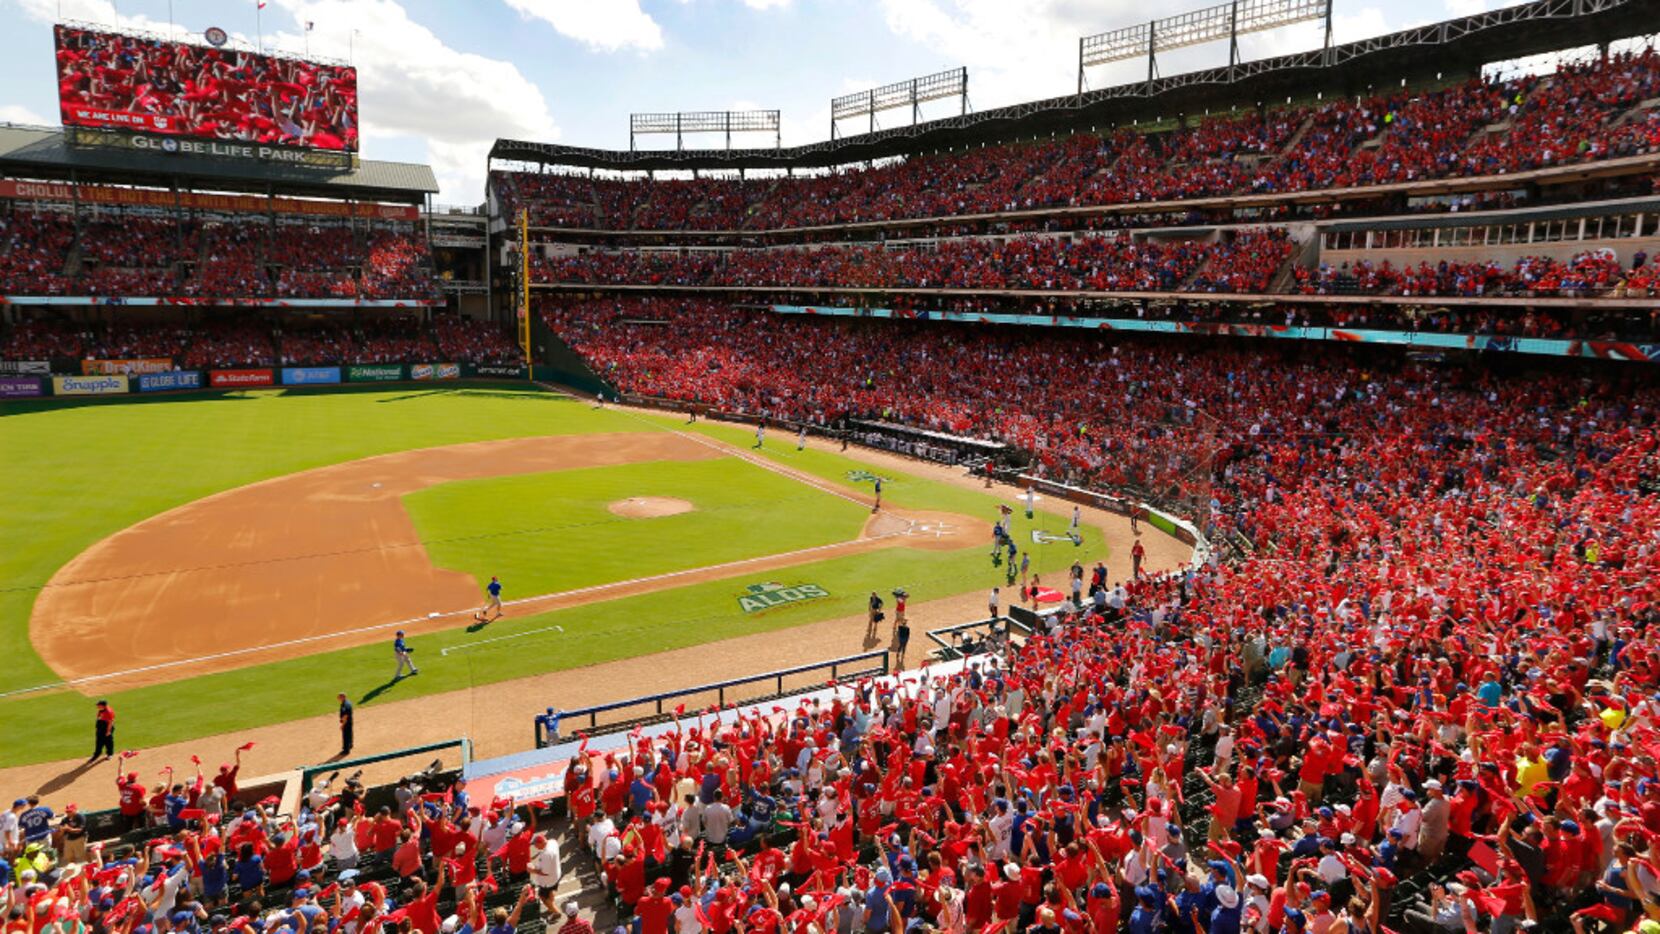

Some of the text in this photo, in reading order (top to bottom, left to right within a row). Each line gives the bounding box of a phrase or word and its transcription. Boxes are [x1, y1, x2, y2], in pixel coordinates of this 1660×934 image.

[92, 111, 109, 120] ARE
[111, 113, 129, 122] LIVE
[211, 142, 253, 158] LIFE
[259, 147, 306, 162] PARK
[62, 378, 120, 392] Snapple
[178, 374, 199, 386] LIFE
[738, 584, 831, 613] ALDS
